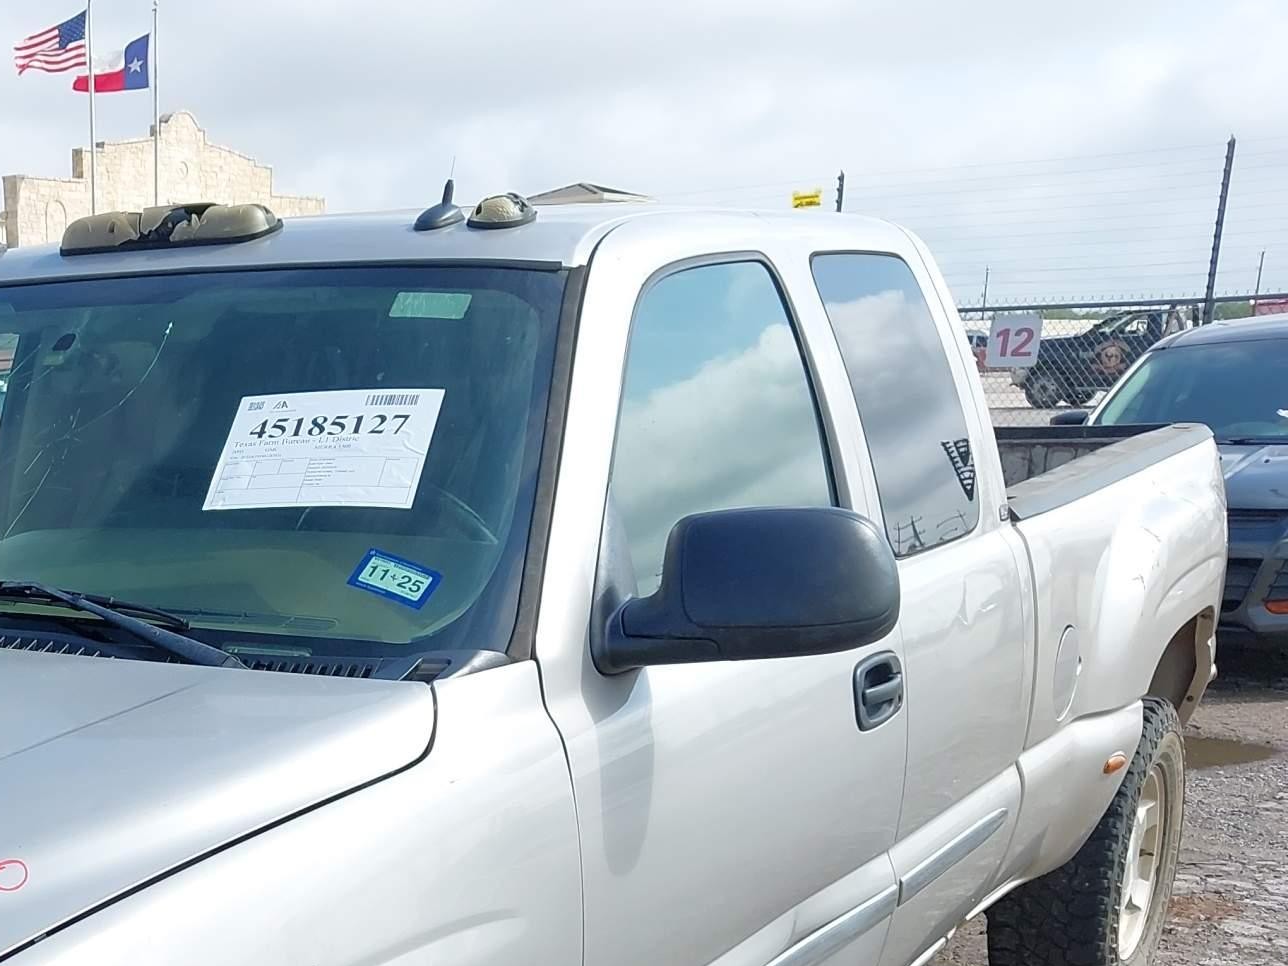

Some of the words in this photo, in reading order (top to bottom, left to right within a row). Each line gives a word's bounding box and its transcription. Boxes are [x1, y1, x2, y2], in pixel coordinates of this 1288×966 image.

[995, 326, 1035, 358] 12
[249, 413, 412, 440] 45185127
[233, 440, 258, 449] Texas
[258, 438, 280, 448] Farm
